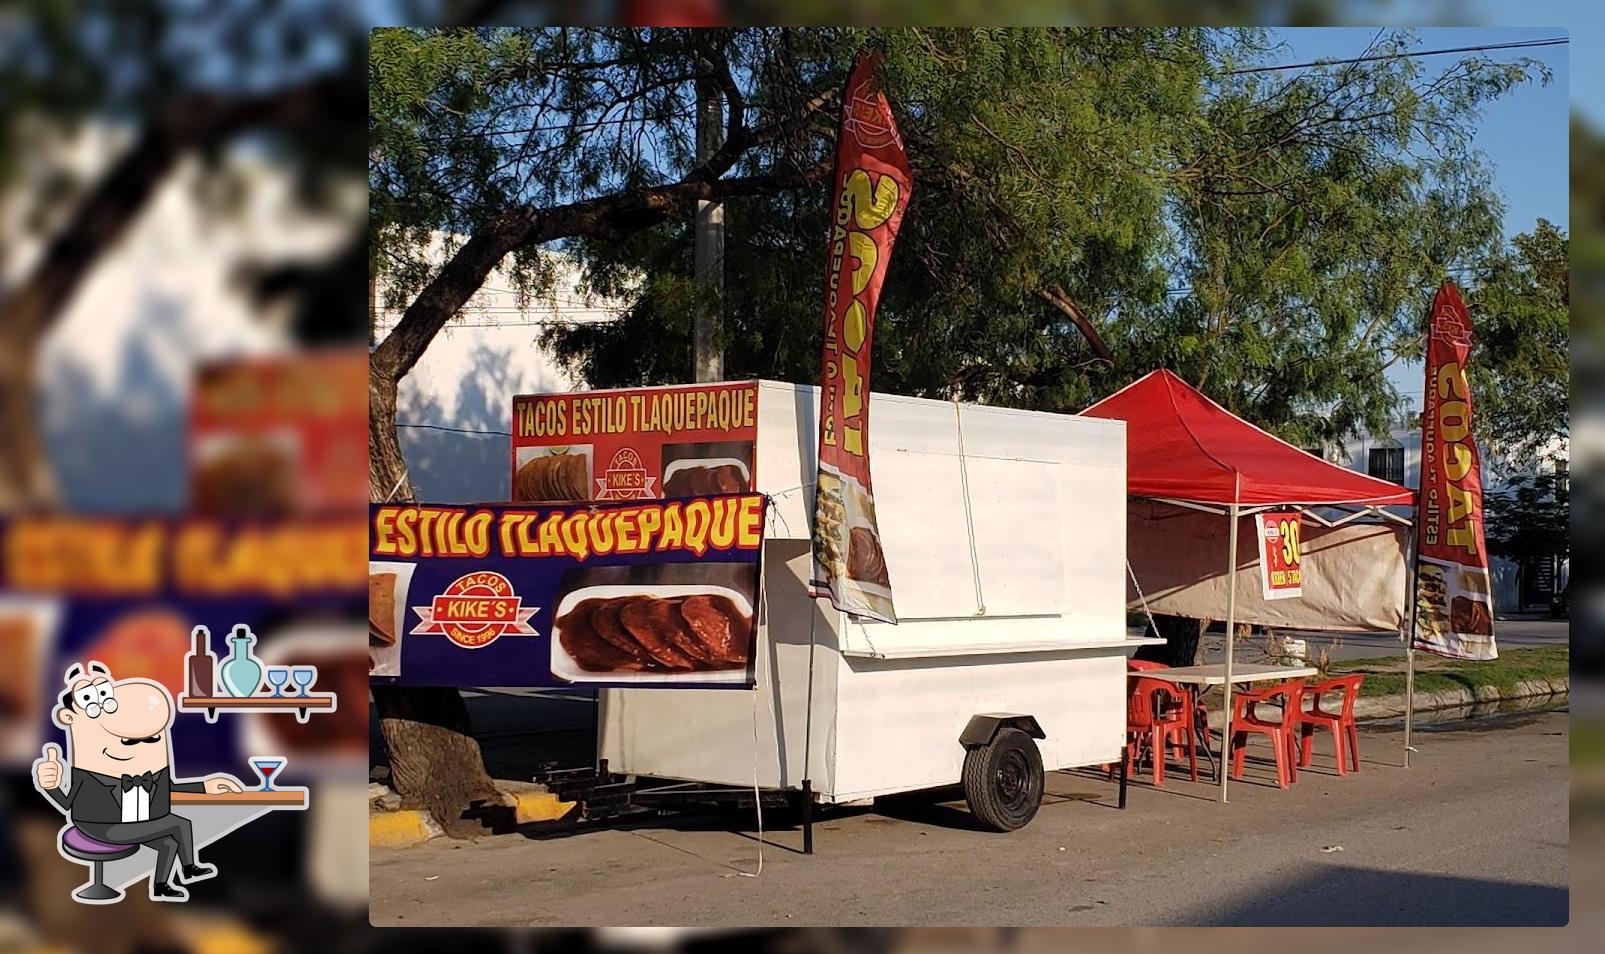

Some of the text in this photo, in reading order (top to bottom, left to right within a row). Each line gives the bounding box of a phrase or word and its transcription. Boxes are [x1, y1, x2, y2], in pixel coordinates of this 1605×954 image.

[516, 389, 755, 437] TACOS ESTILO TLAQUEPAQUE
[615, 450, 638, 466] TACOS
[612, 473, 641, 487] KIKE'S
[374, 507, 493, 556] ESTILO
[500, 495, 763, 561] TLAQUEPAQUE
[1280, 518, 1300, 567] 30
[455, 574, 507, 593] TACOS
[447, 600, 507, 618] KIKE'S
[450, 627, 496, 645] SINCE 1996
